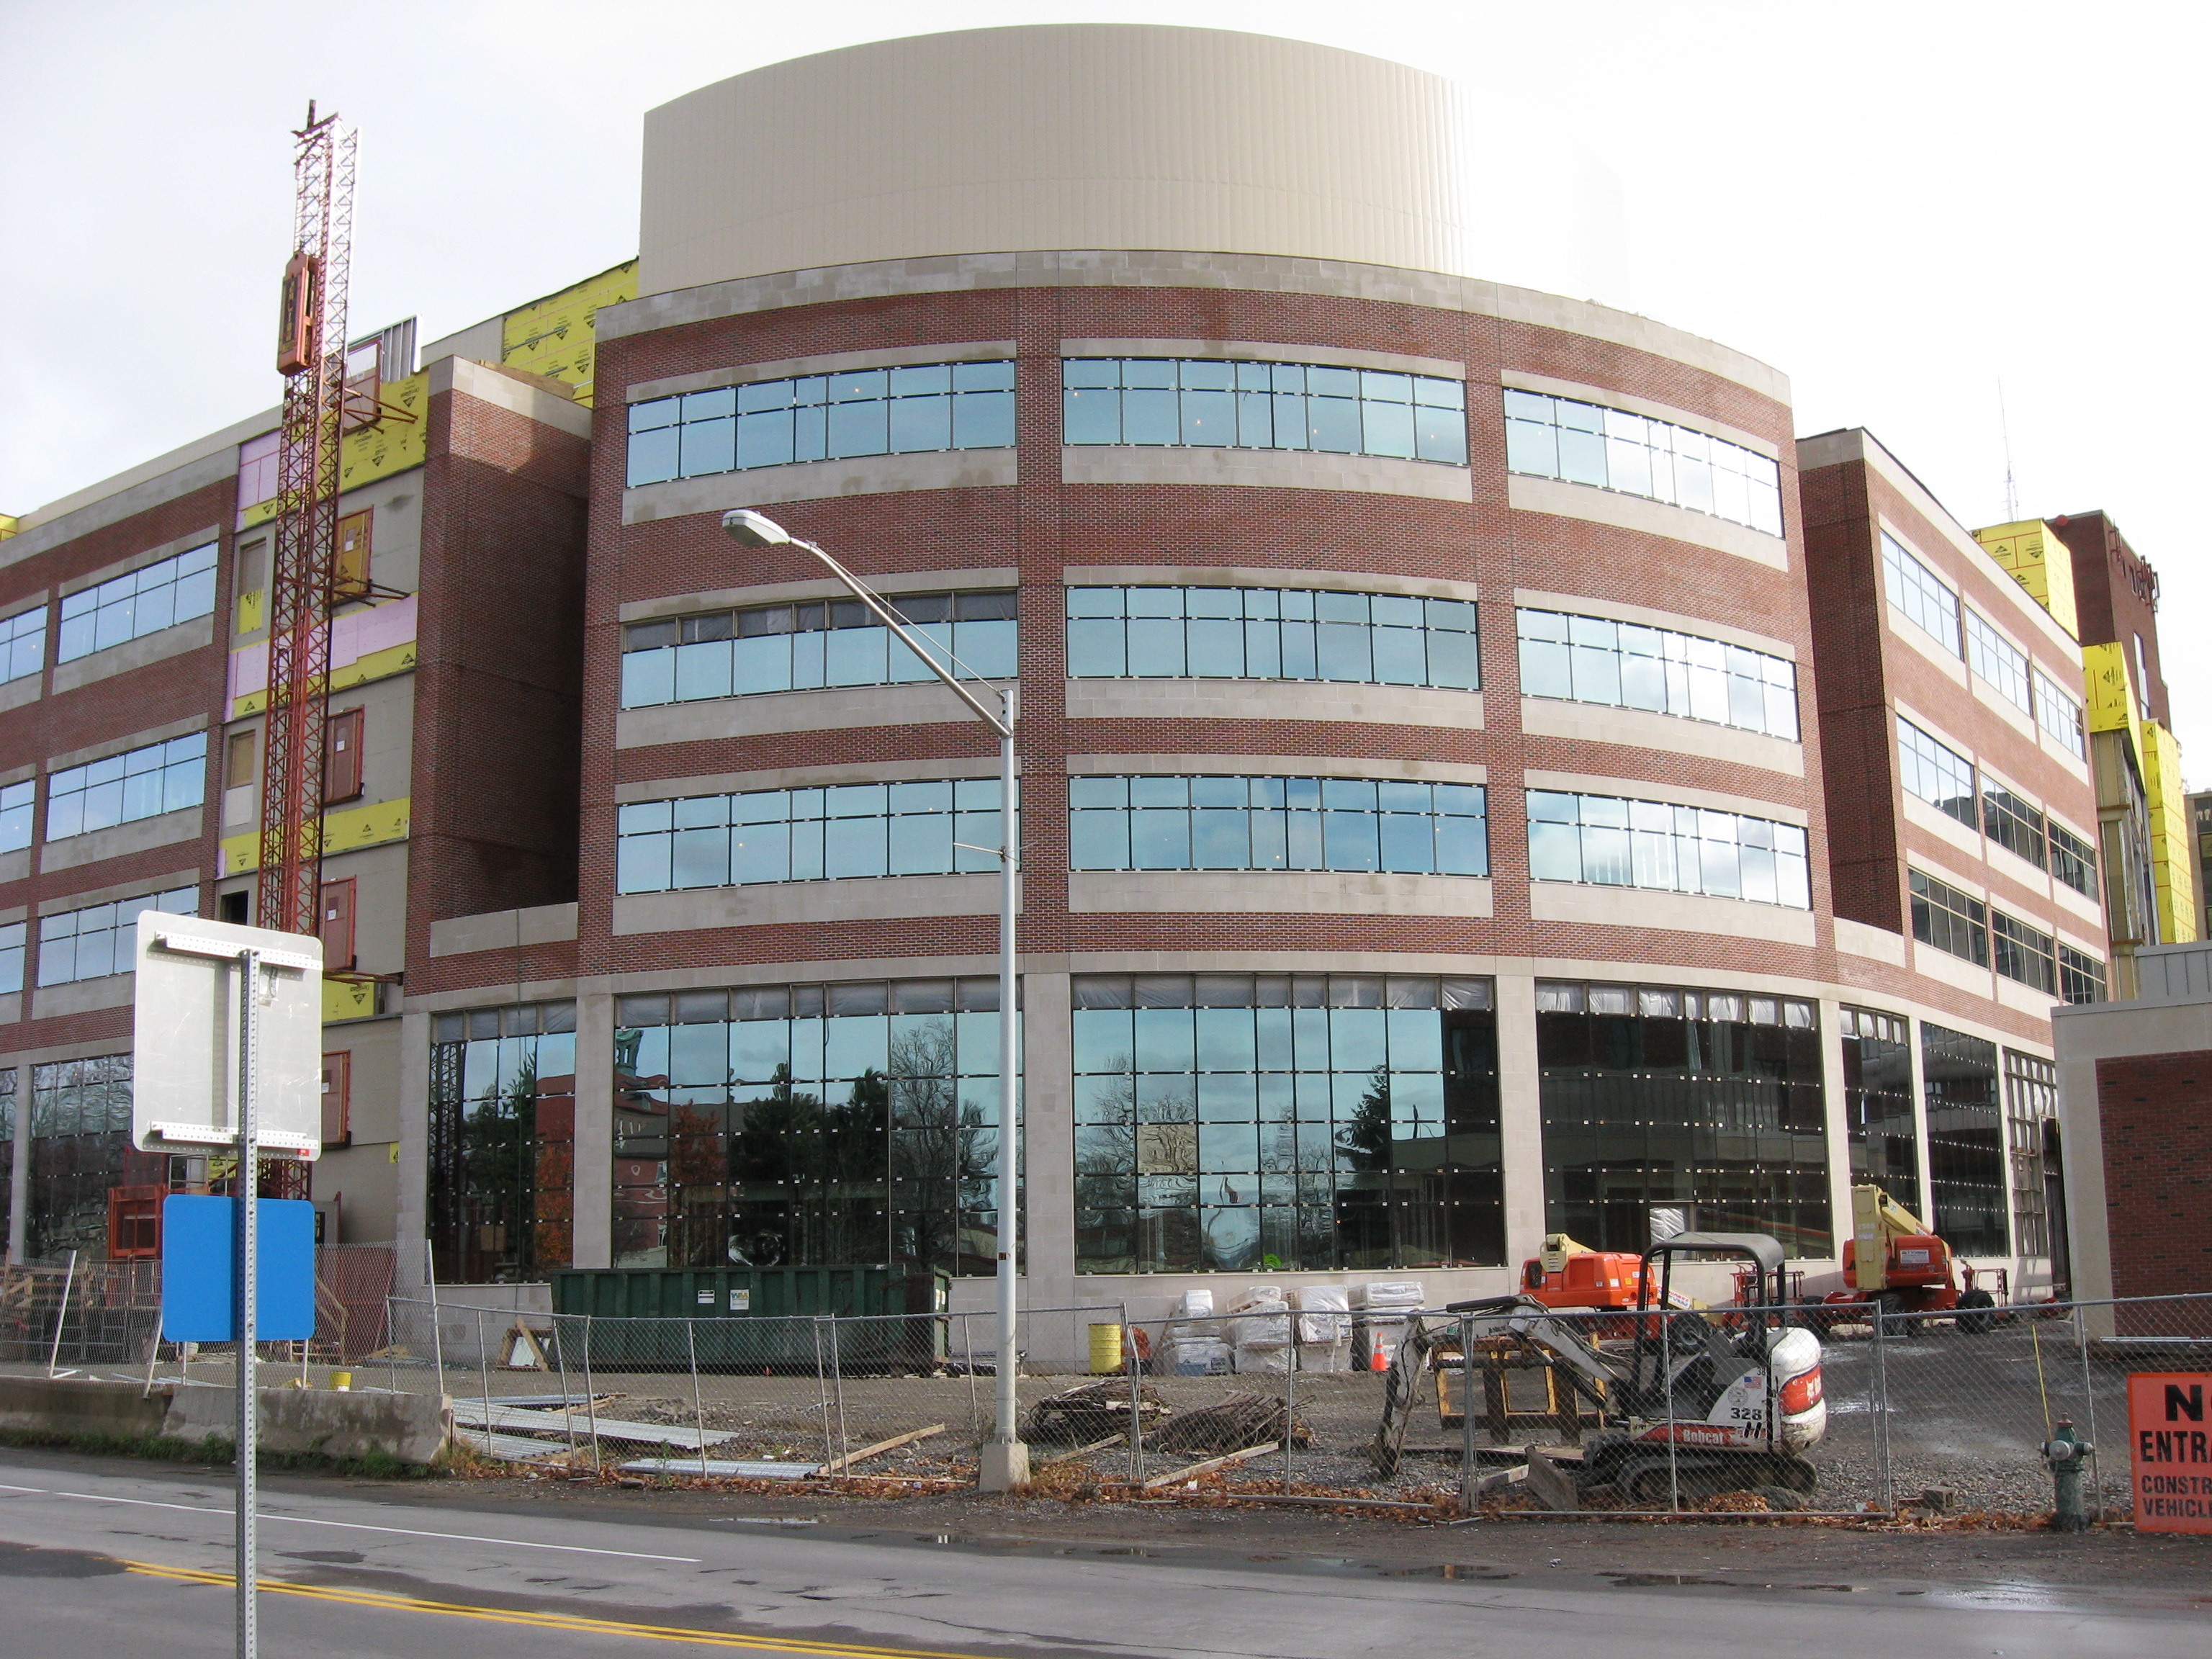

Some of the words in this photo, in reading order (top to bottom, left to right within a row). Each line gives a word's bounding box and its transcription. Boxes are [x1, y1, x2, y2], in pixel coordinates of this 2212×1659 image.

[2164, 1384, 2212, 1421] N
[1730, 1407, 1762, 1420] 328
[1683, 1429, 1724, 1444] Bobcat
[2139, 1430, 2212, 1463] ENTR
[2141, 1475, 2212, 1495] CONSTR
